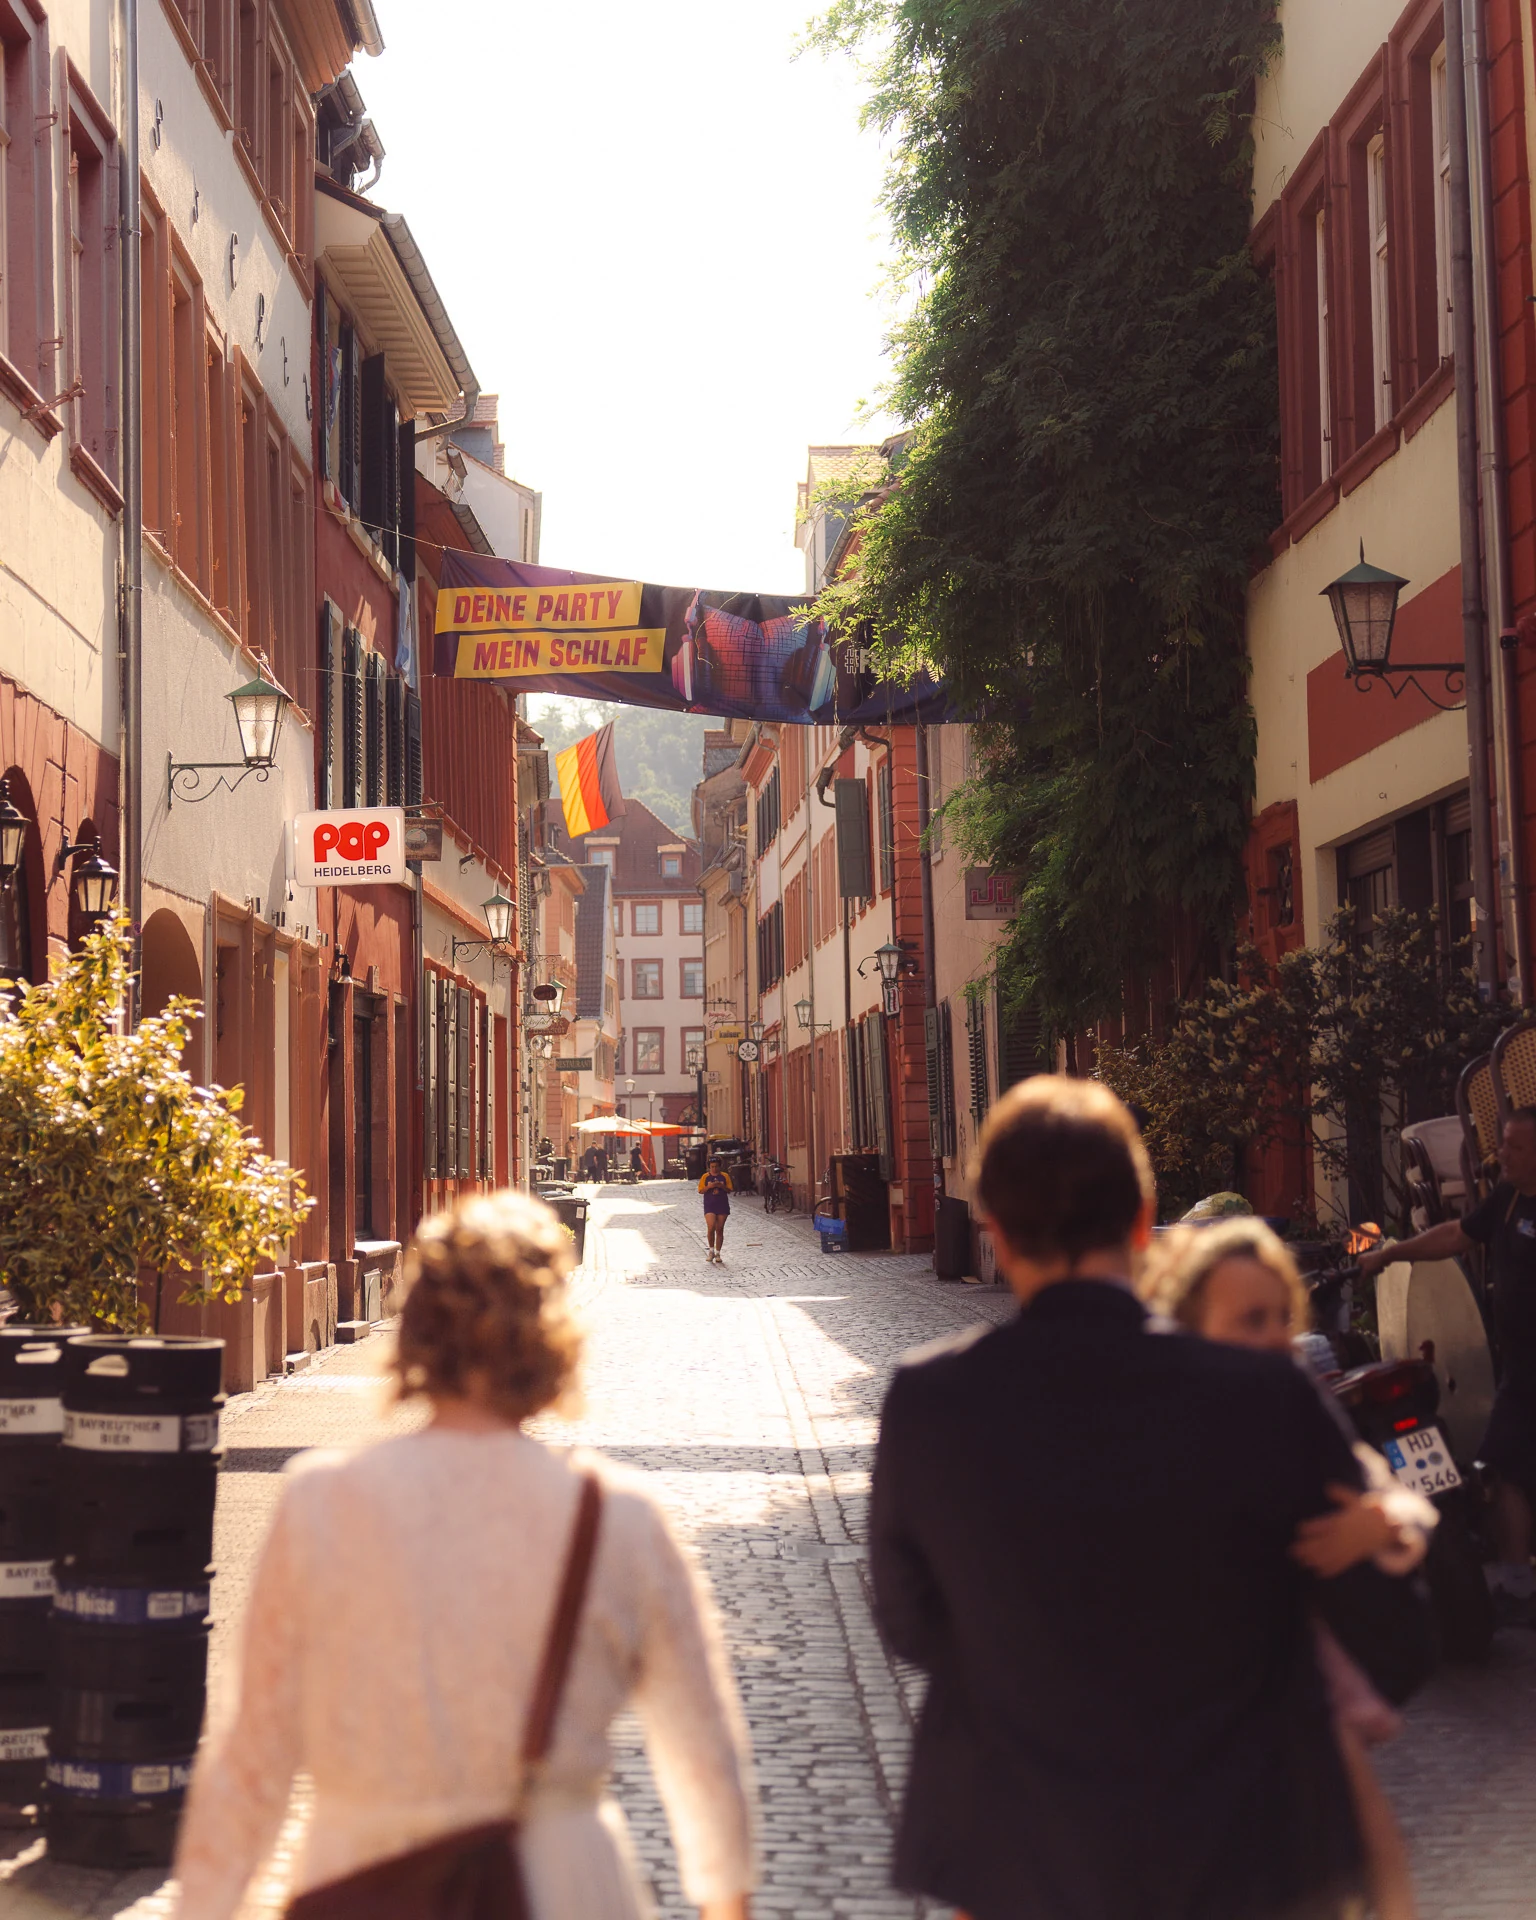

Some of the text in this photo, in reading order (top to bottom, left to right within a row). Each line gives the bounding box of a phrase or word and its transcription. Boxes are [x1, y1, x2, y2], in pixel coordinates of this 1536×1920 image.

[453, 590, 623, 624] DEINE PARTY
[473, 636, 649, 671] MEIN SCHLAF
[313, 821, 390, 863] POP
[314, 864, 391, 878] HEIDELBERG
[79, 1417, 161, 1432] BAYREUTHER
[100, 1434, 131, 1446] BIER
[1406, 1432, 1434, 1453] HD
[1420, 1468, 1458, 1493] 546
